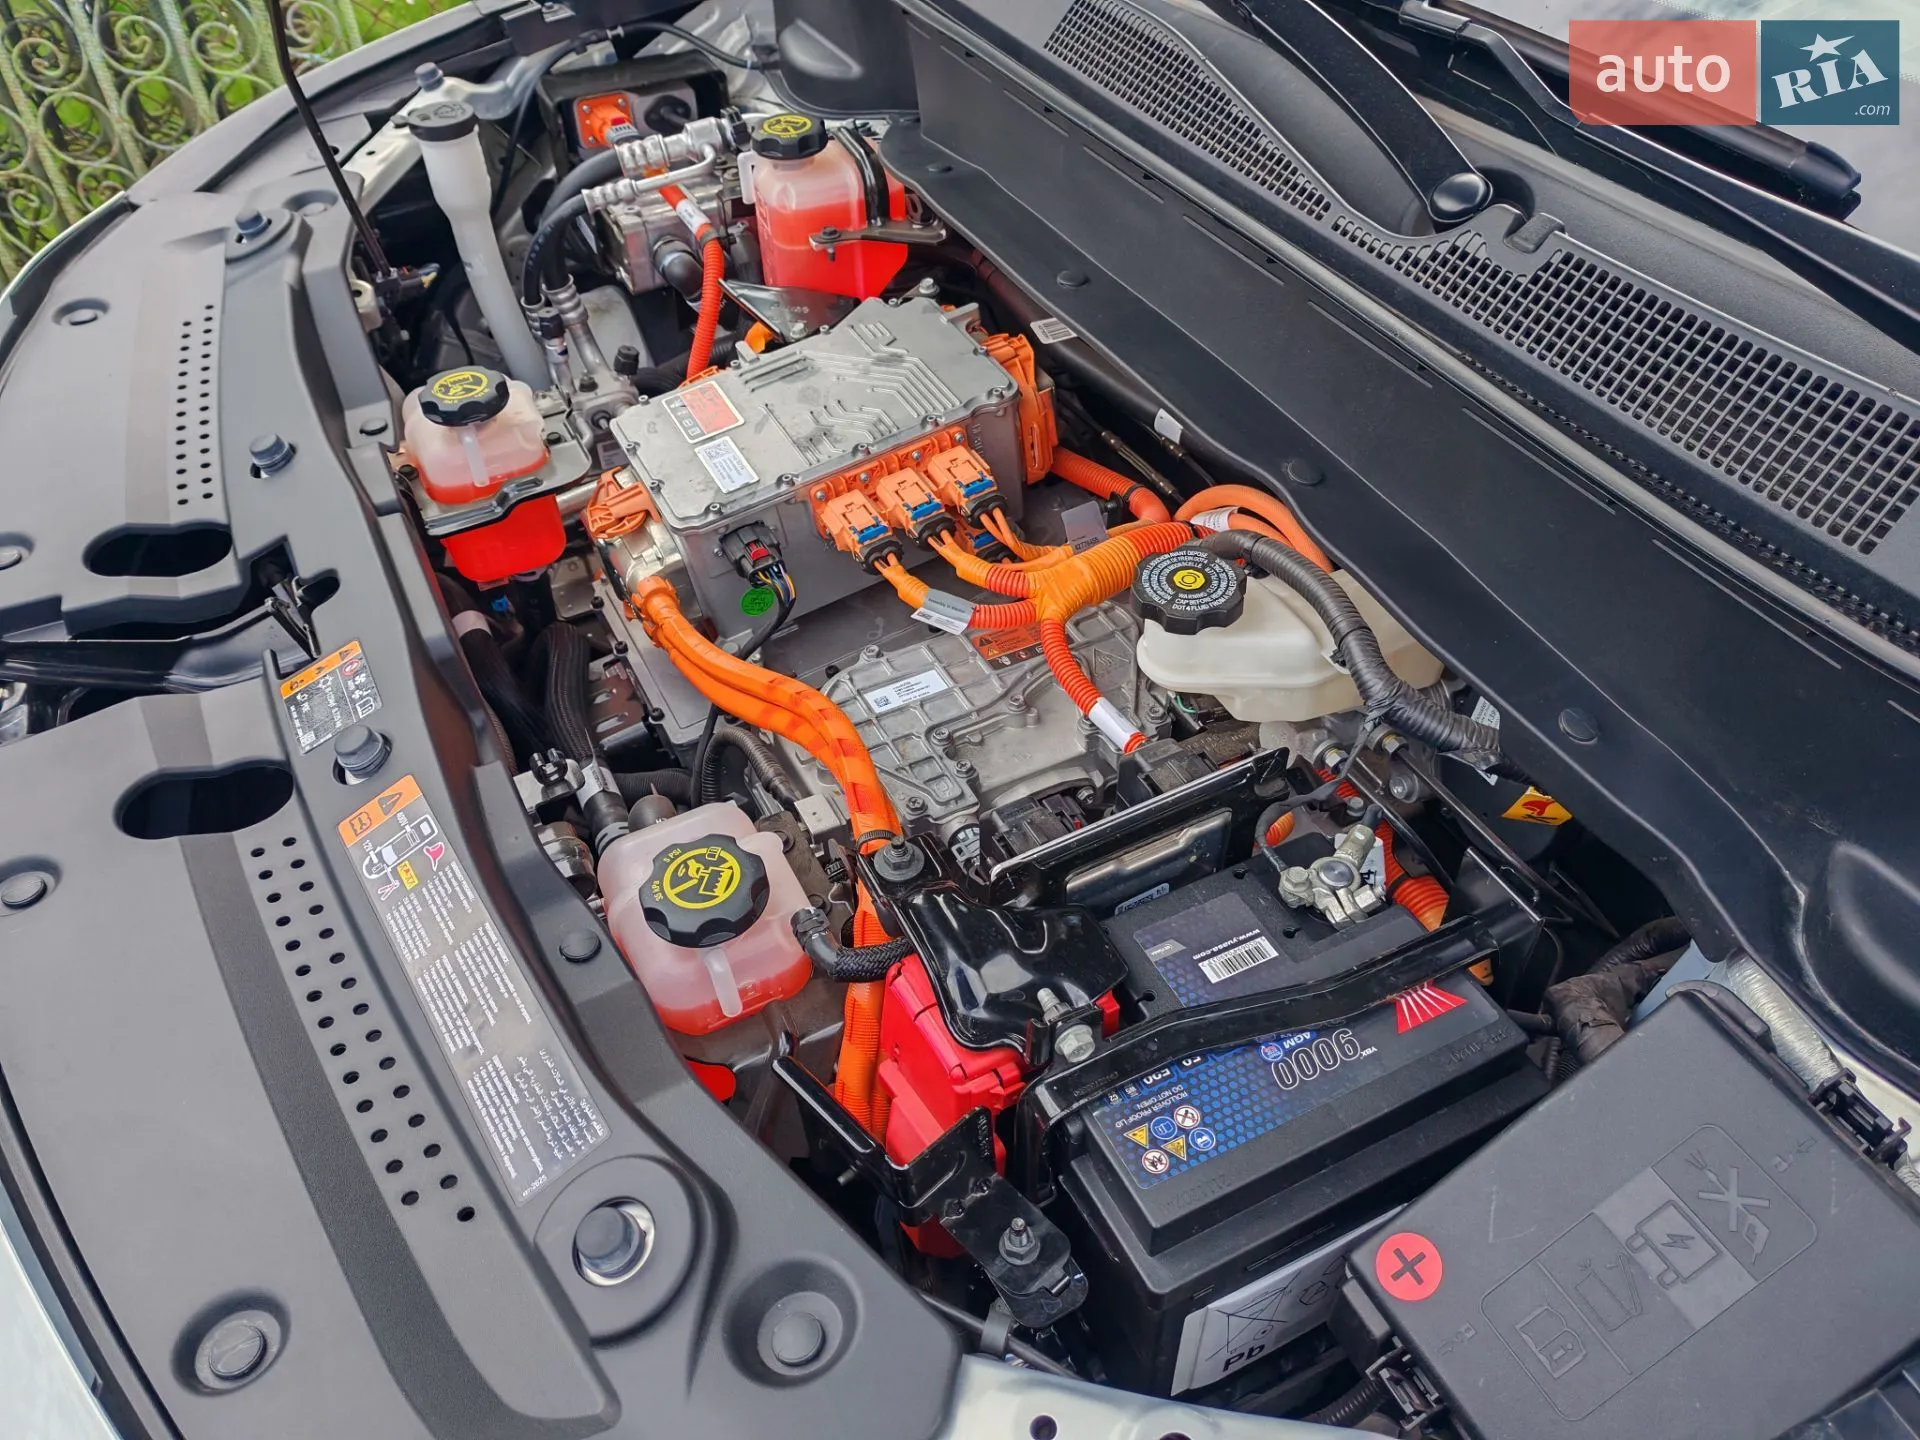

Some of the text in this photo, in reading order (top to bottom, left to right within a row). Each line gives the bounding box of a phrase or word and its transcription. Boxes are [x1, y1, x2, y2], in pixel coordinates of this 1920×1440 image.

[669, 848, 682, 860] PSI
[1192, 928, 1260, 960] www.yuasa.com
[1282, 1030, 1312, 1049] AGM
[1269, 1027, 1361, 1091] 9000
[1135, 1095, 1157, 1110] OPEN
[1151, 1089, 1187, 1111] ROLLOVER
[1154, 1088, 1172, 1100] NOT
[1125, 1105, 1152, 1123] PROOF
[1222, 1344, 1265, 1373] Pb
